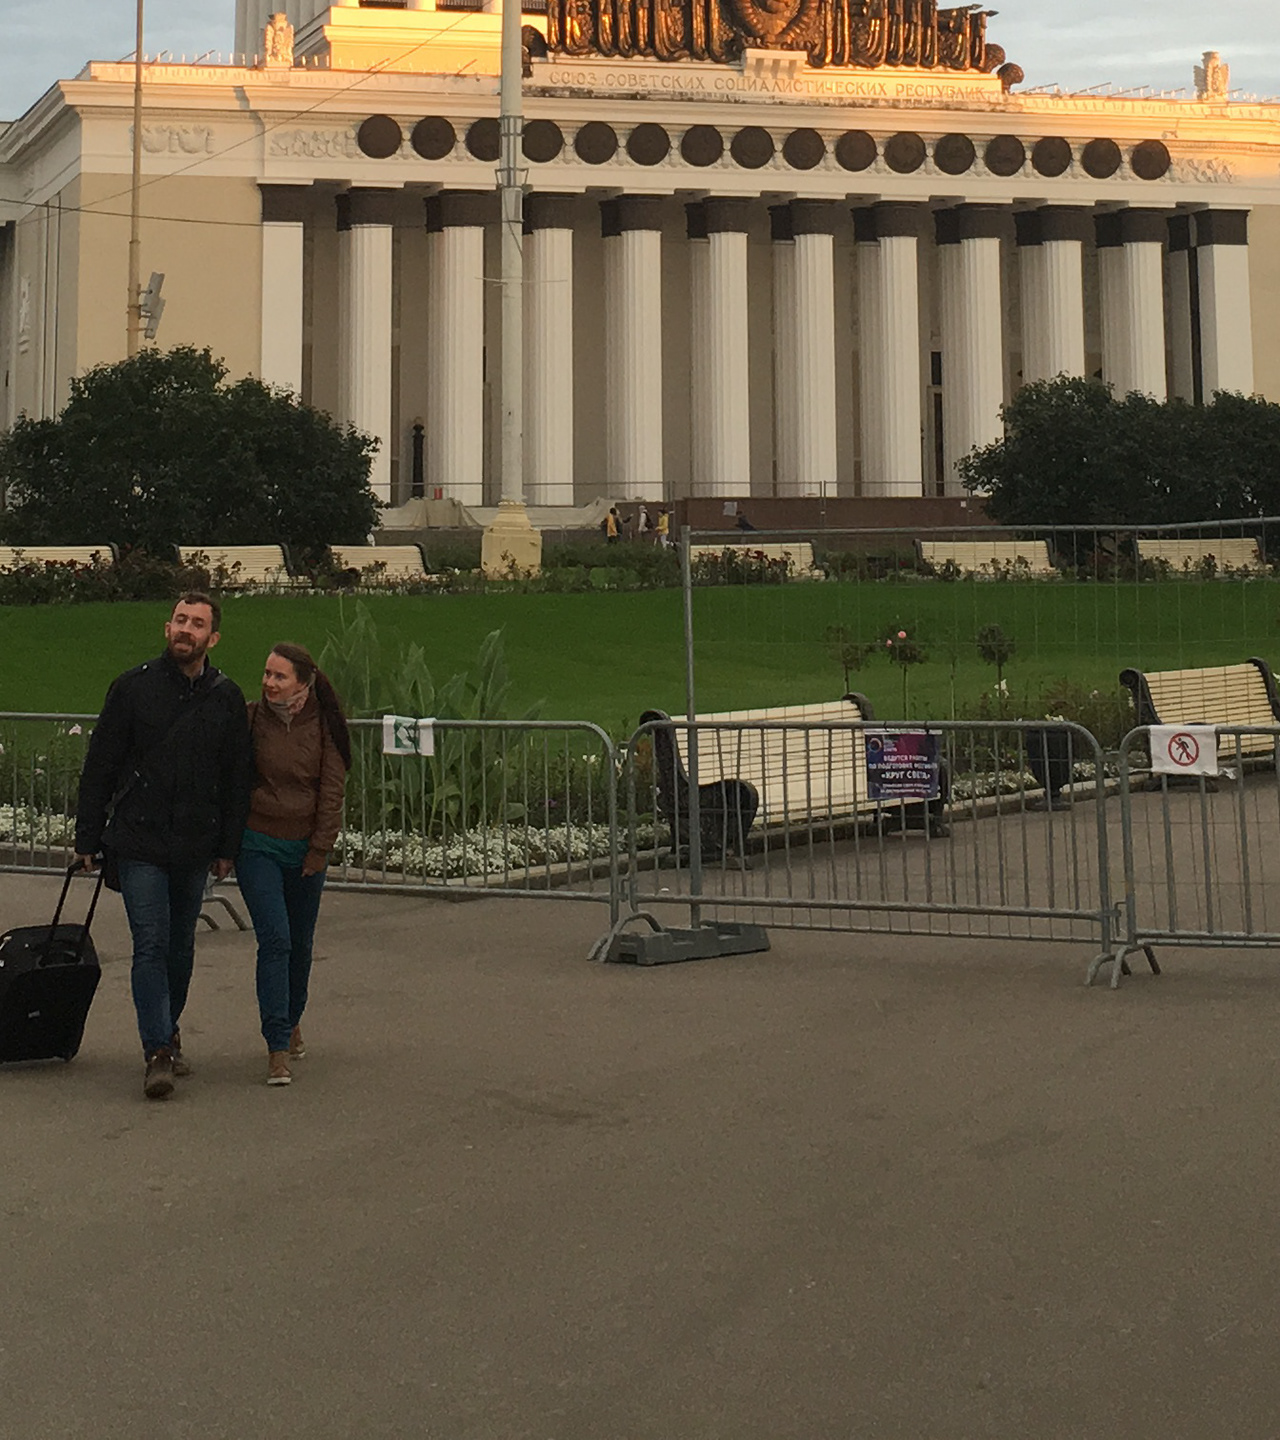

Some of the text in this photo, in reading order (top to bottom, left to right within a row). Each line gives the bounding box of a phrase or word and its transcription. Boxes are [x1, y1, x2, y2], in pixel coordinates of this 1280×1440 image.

[549, 71, 986, 101] СОЮЗ СОВЕТСКИХ СОЦИАЛИСТИЧЕСКИХ РЕСПУБЛИК
